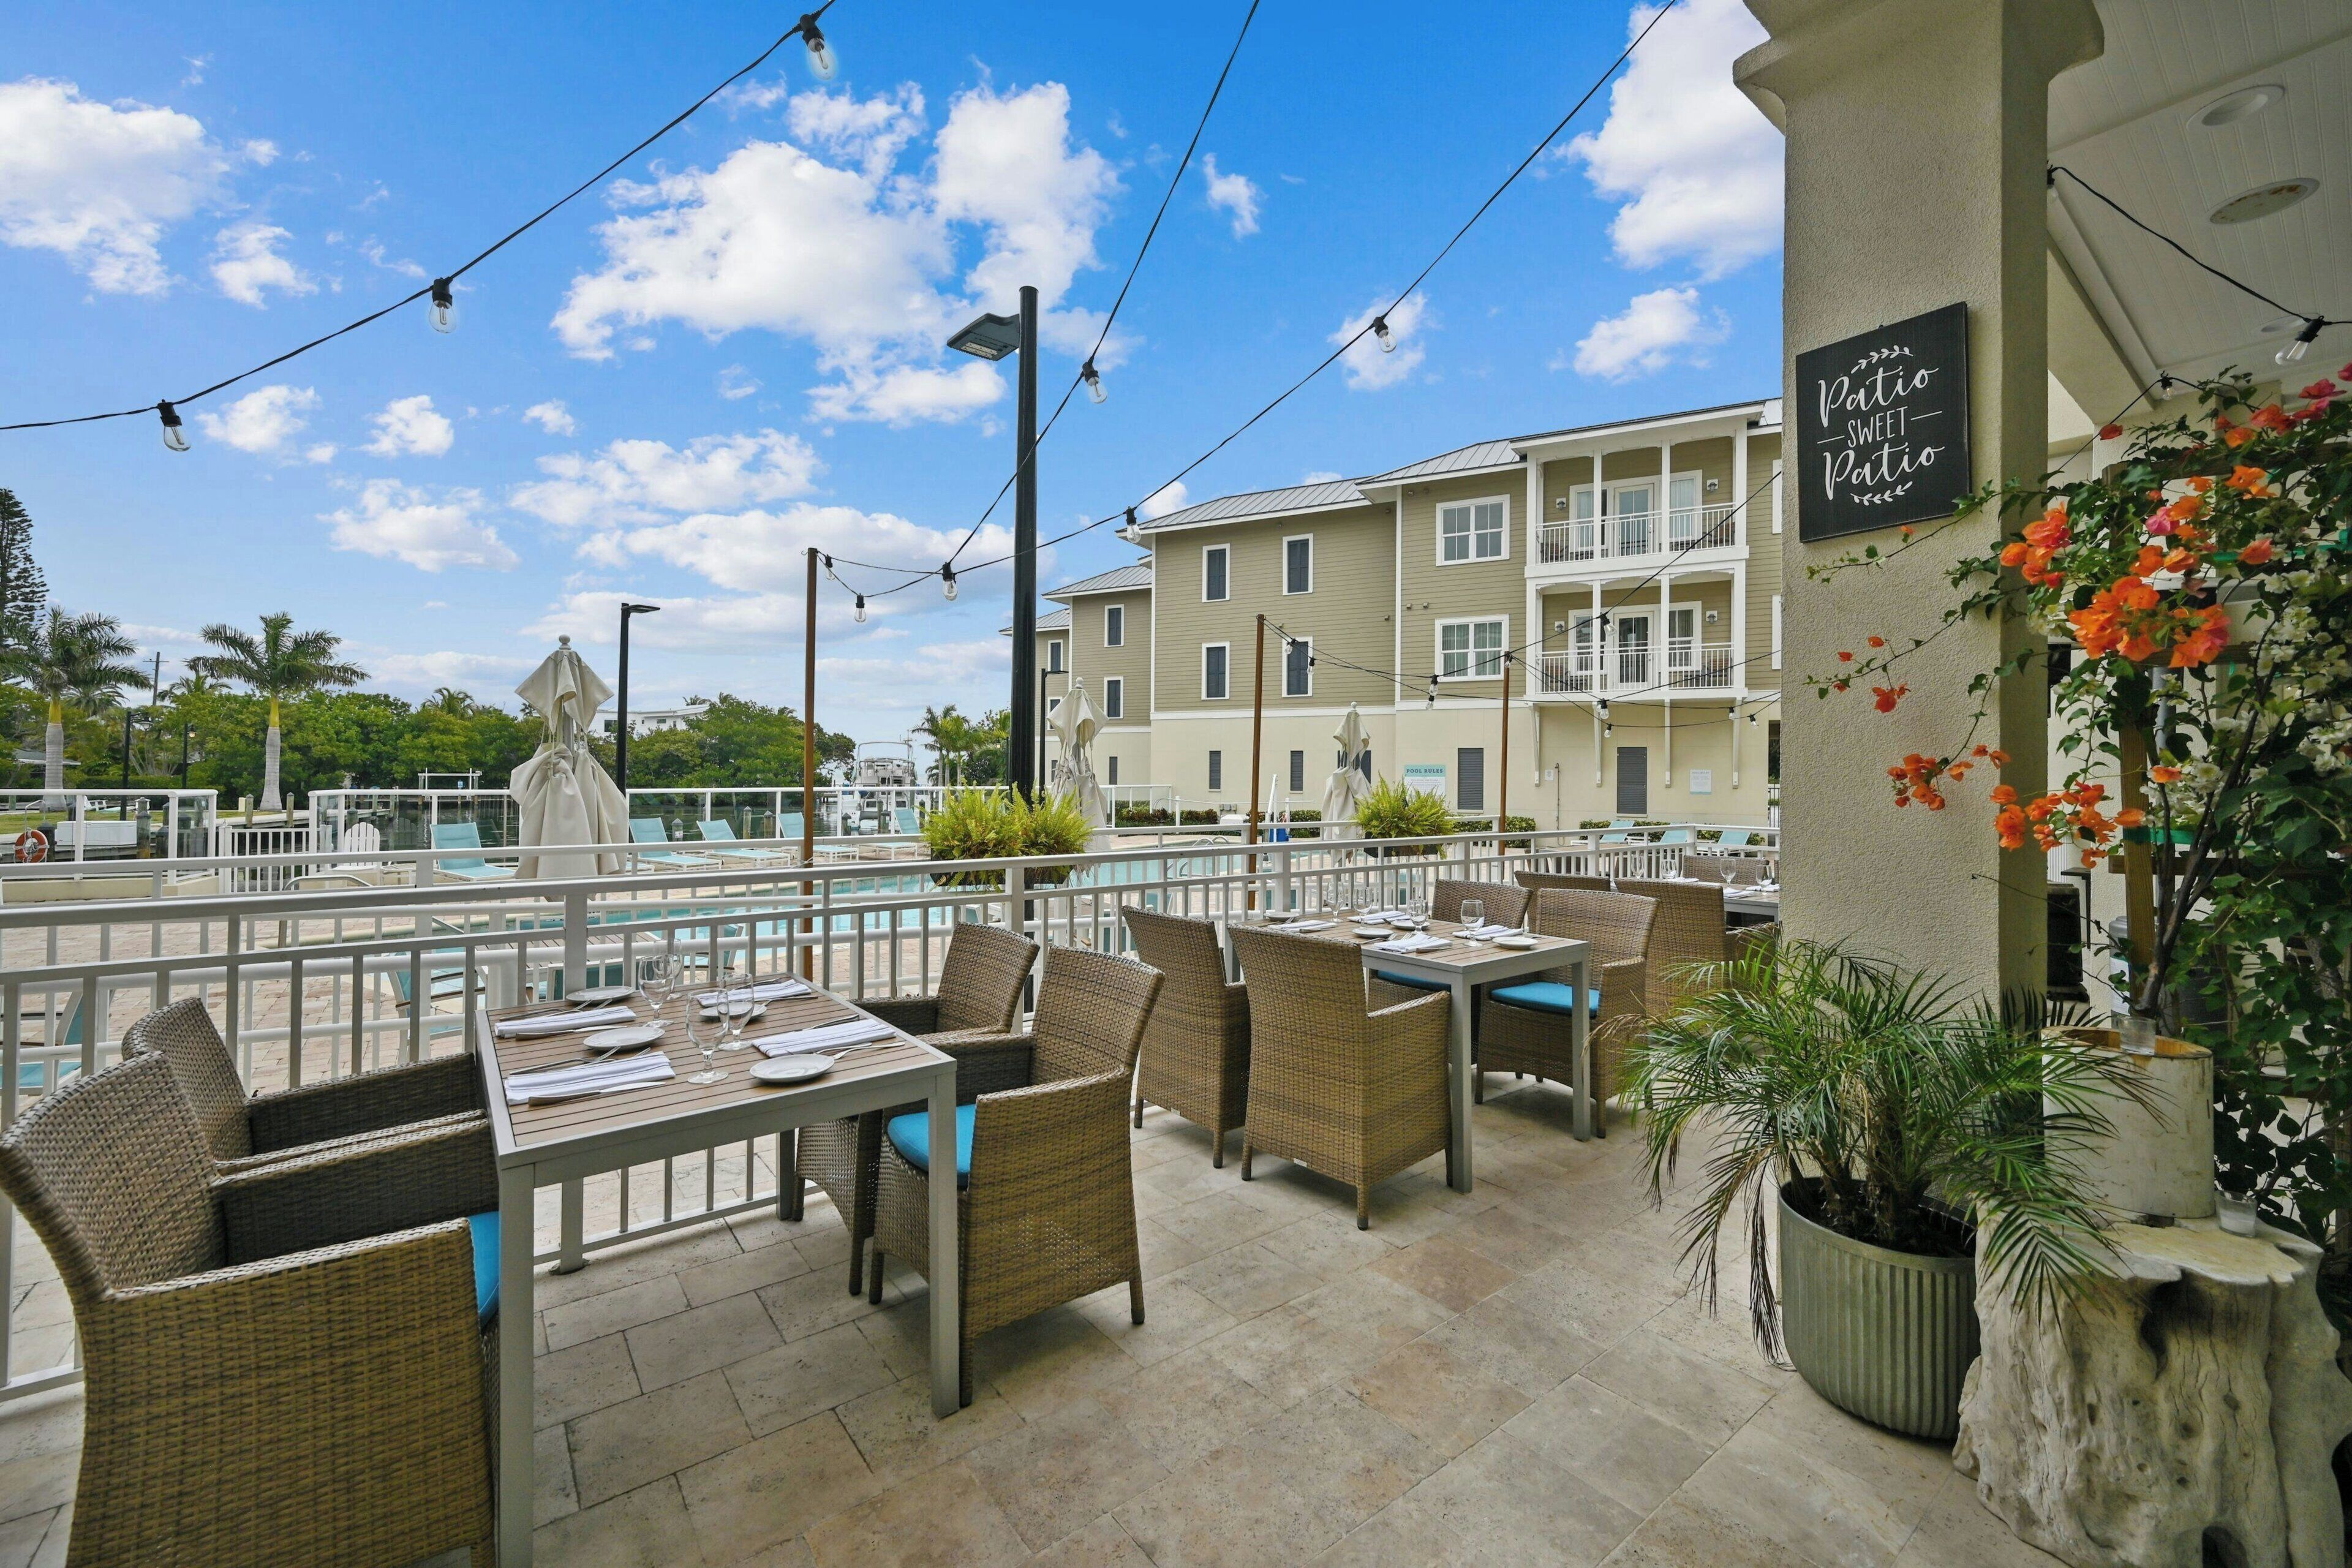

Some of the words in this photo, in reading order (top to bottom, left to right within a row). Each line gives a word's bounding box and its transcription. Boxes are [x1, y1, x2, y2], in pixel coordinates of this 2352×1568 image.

[1817, 366, 1939, 428] Patio
[1847, 406, 1908, 448] SWEET
[1823, 442, 1945, 500] Patio
